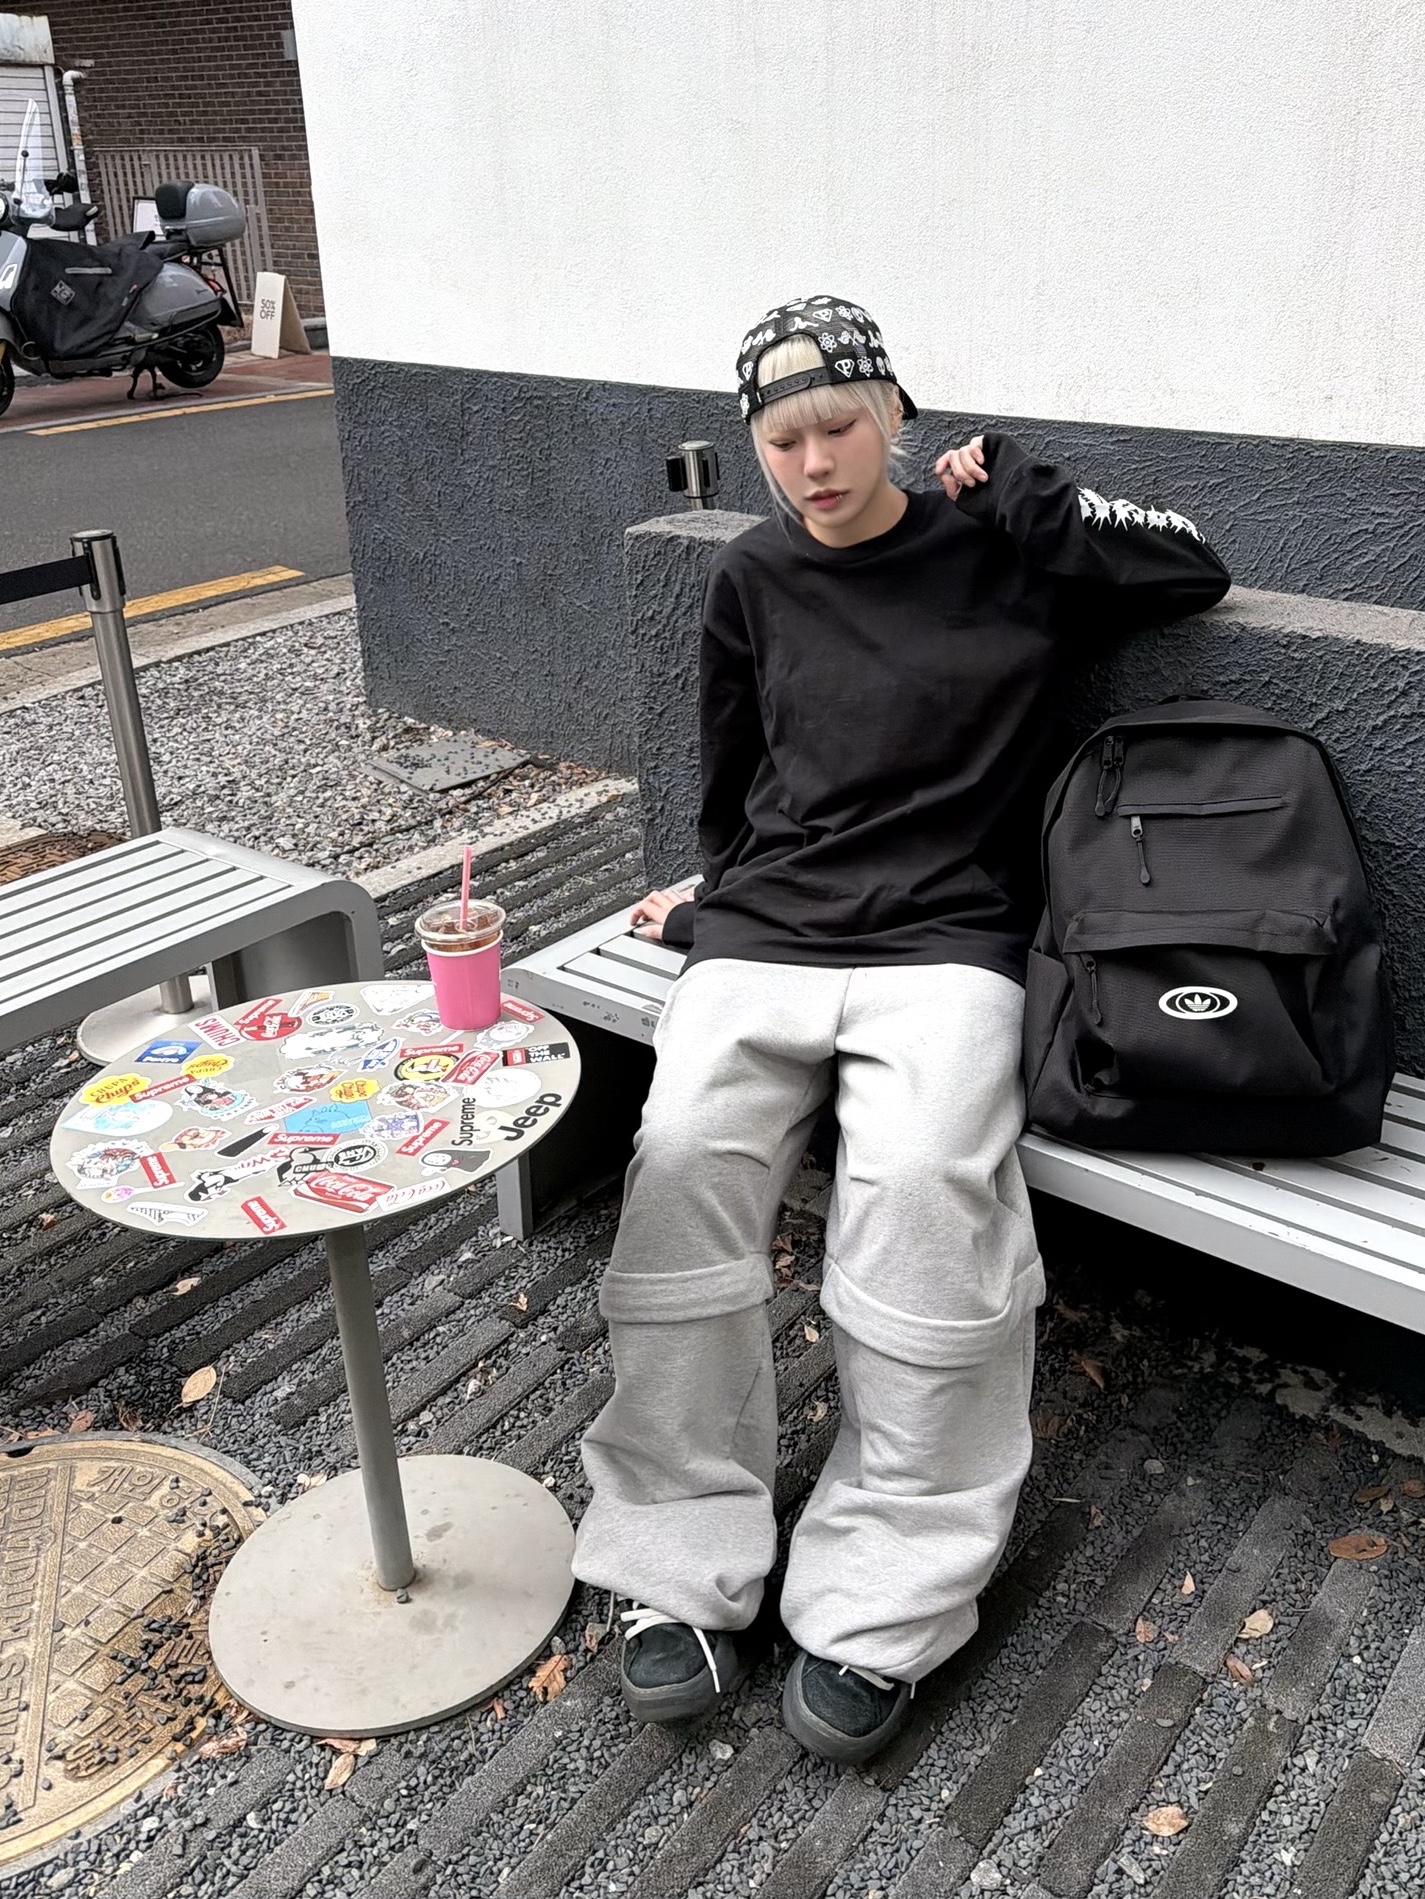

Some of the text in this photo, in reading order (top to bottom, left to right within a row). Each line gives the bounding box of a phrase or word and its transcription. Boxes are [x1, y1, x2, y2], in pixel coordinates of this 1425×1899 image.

[260, 298, 276, 310] 50%
[260, 309, 276, 320] OFF
[503, 1002, 540, 1021] Supreme
[194, 1017, 241, 1047] CHUMS
[404, 1045, 460, 1056] Supreme
[528, 1044, 550, 1052] OFF
[530, 1052, 566, 1063] WALL
[90, 1078, 129, 1098] CHUPA
[92, 1079, 141, 1105] Chups
[133, 1076, 191, 1101] Supreme
[451, 1097, 477, 1147] Supreme
[498, 1092, 563, 1142] Jeep
[273, 1133, 335, 1144] Supreme
[401, 1121, 443, 1154] Supreme
[146, 1155, 171, 1187] Supreme
[246, 1199, 280, 1232] Supreme
